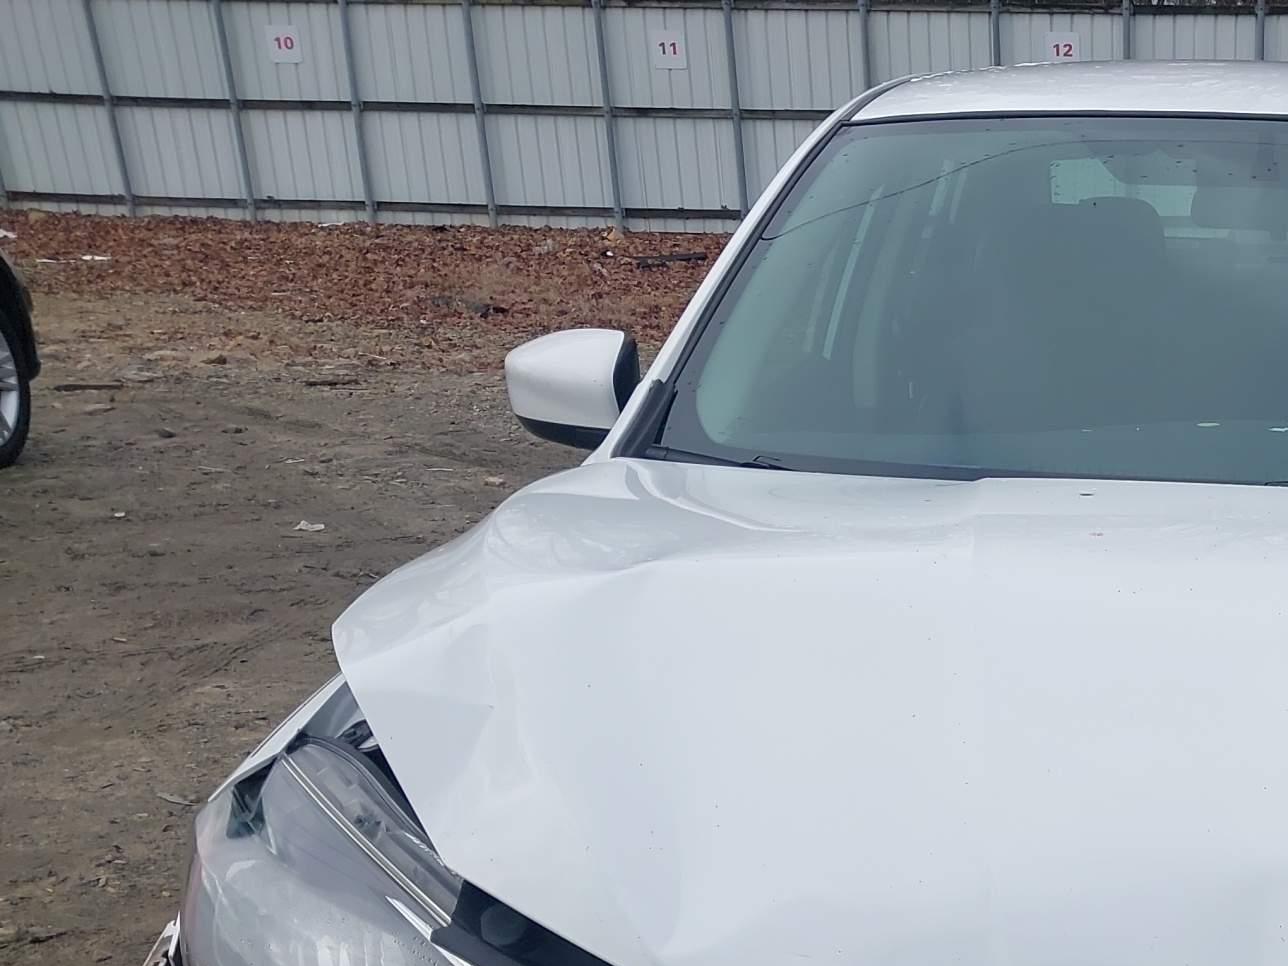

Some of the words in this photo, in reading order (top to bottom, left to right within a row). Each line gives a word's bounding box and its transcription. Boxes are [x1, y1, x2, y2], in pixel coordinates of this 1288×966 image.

[273, 36, 295, 50] 10
[658, 41, 678, 55] 11
[1053, 43, 1074, 57] 12
